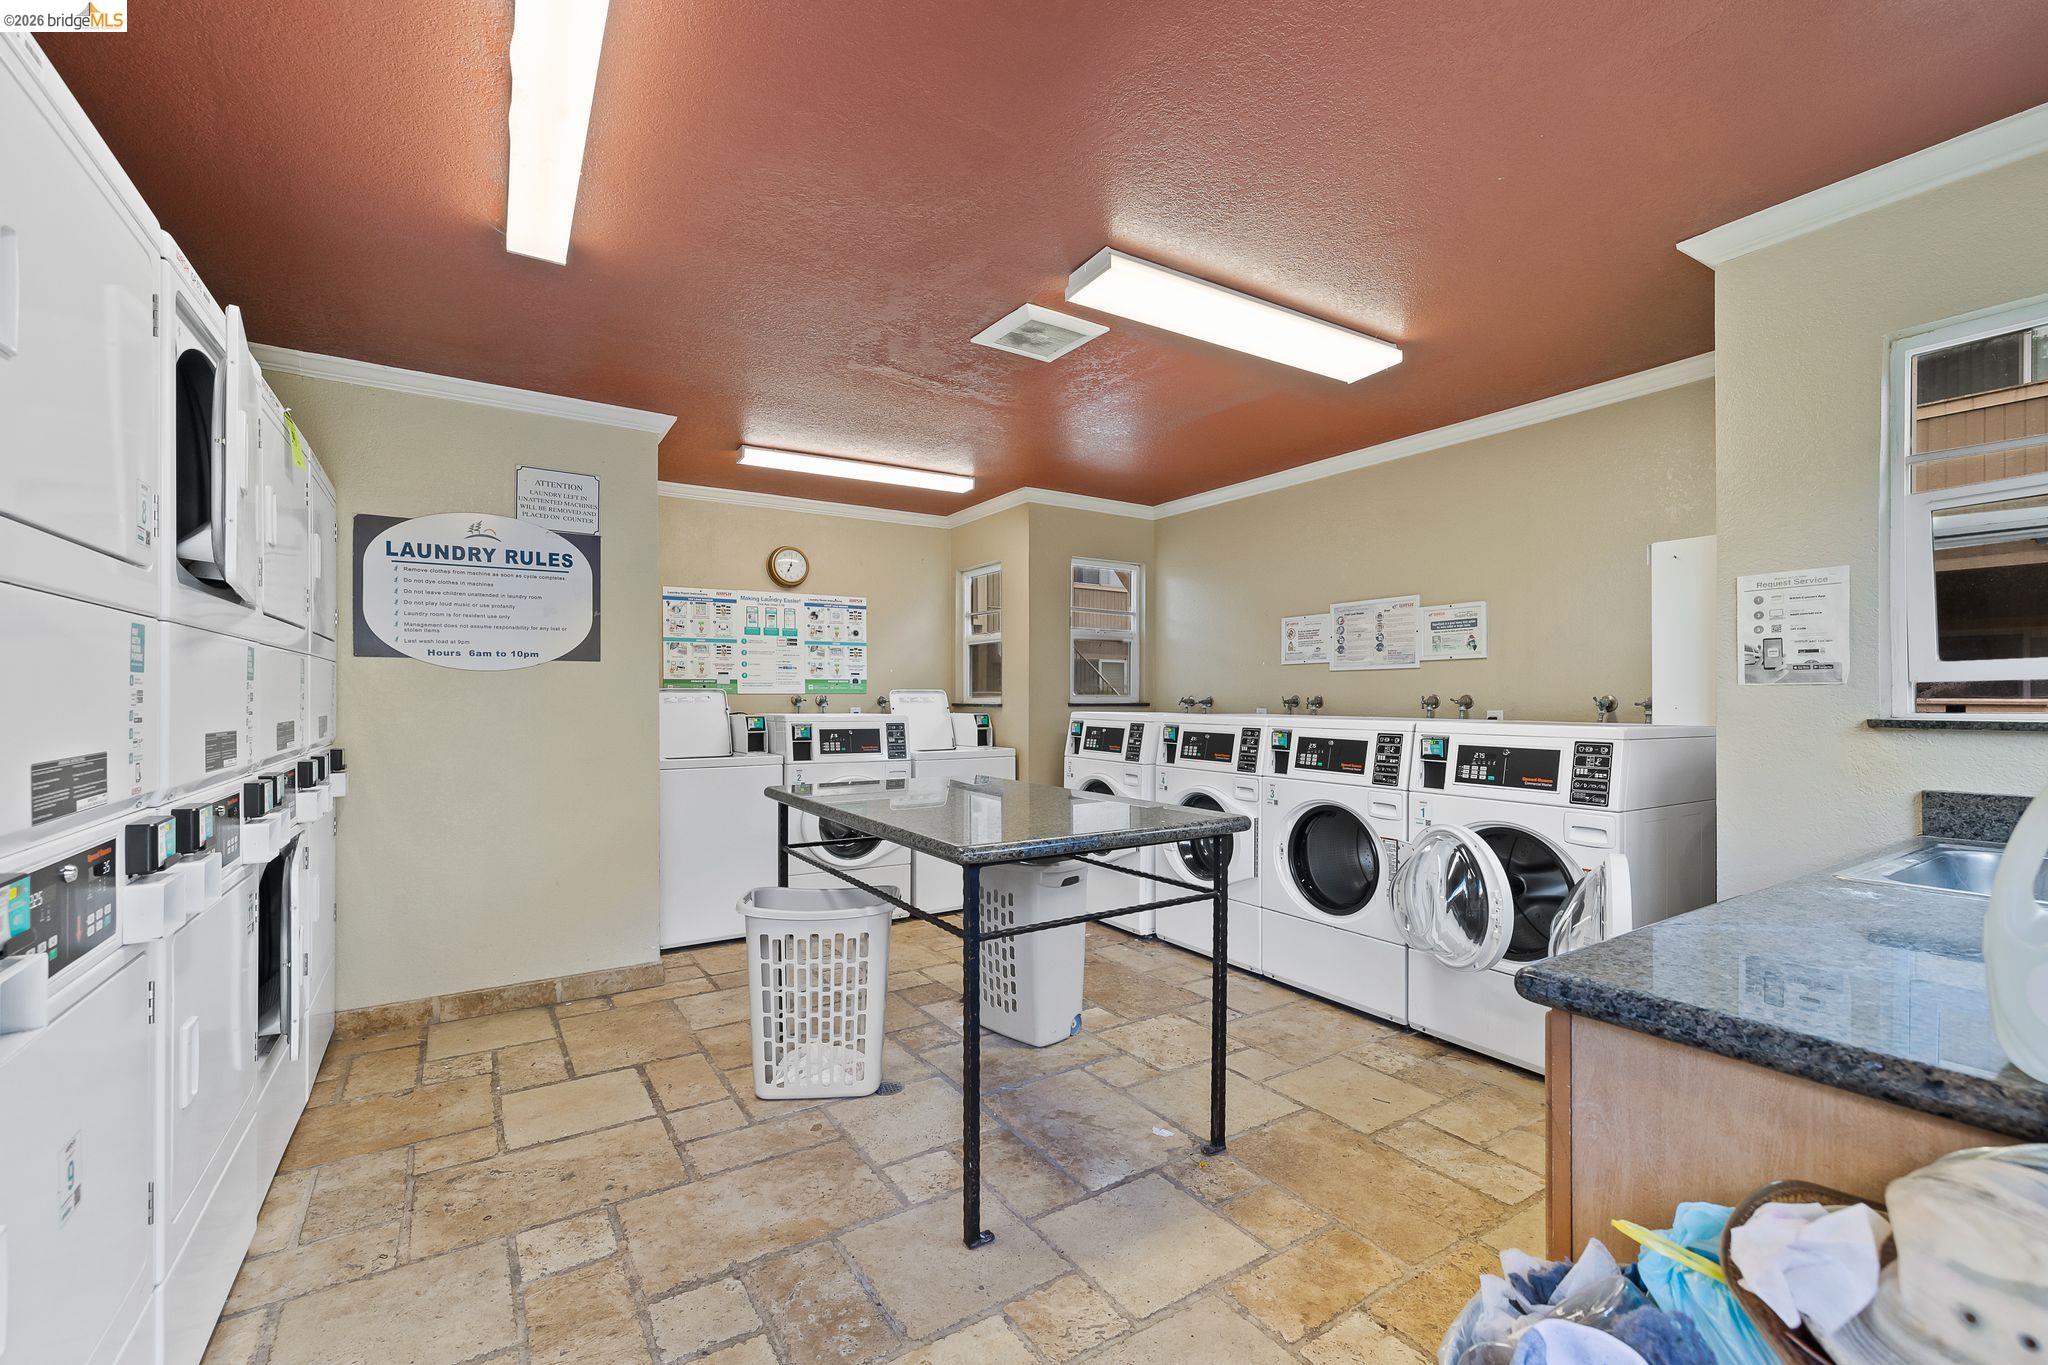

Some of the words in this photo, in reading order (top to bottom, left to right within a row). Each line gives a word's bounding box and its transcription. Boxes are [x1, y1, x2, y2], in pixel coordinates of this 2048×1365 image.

[534, 480, 584, 492] ATTENTION
[530, 489, 562, 499] LAUNDRY
[548, 506, 582, 515] REMOVED
[564, 502, 599, 510] MACHINES
[142, 500, 147, 525] 8
[562, 516, 594, 524] COUNTER
[385, 540, 496, 563] LAUNDRY
[504, 548, 574, 568] RULES
[1756, 580, 1792, 590] Request
[1793, 576, 1829, 586] Service
[740, 595, 760, 603] Making
[427, 649, 462, 657] Hours
[468, 649, 492, 657] 6am
[510, 651, 540, 659] 10pm
[1270, 789, 1275, 798] 3
[1420, 808, 1425, 818] 1
